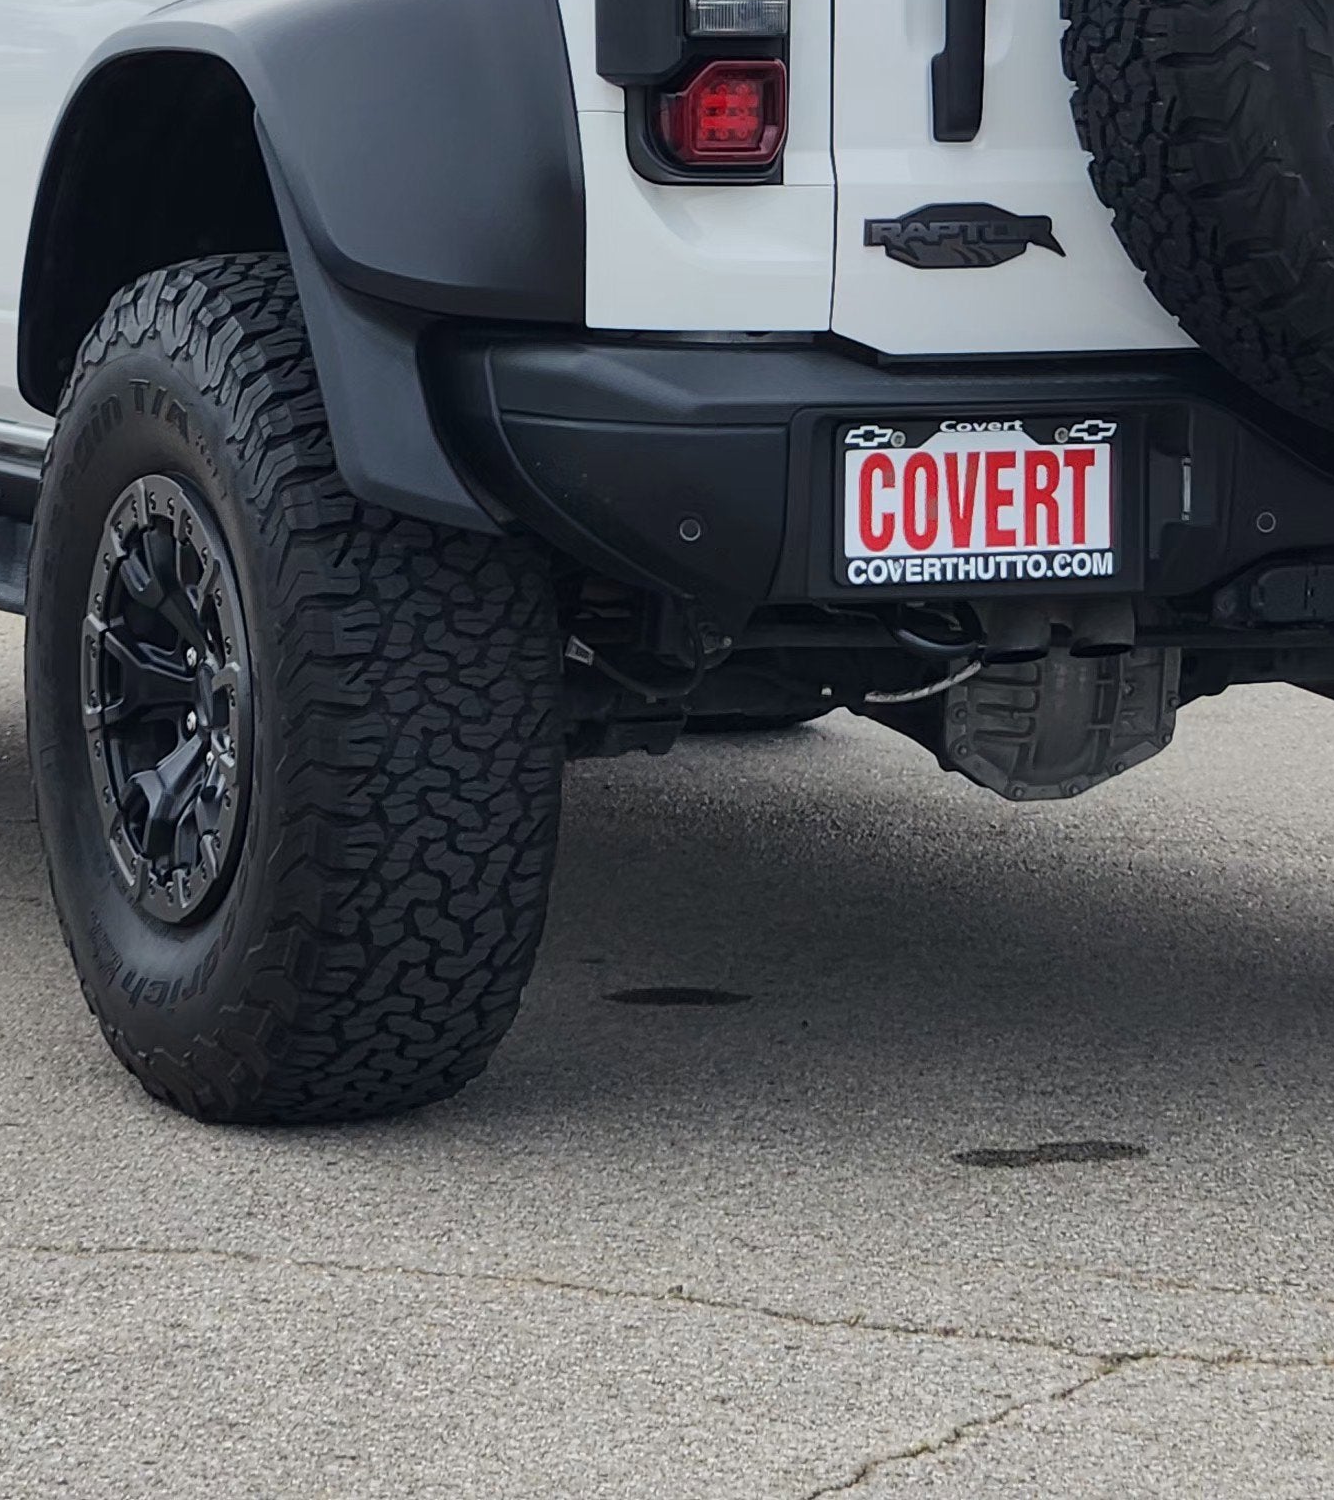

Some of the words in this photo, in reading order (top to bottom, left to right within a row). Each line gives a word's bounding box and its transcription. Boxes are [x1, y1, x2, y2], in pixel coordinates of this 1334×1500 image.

[869, 219, 1067, 258] RAPTOR
[940, 419, 1023, 433] Covert
[858, 447, 1096, 553] COVERT
[846, 551, 1114, 586] COVERTHUTTO.COM
